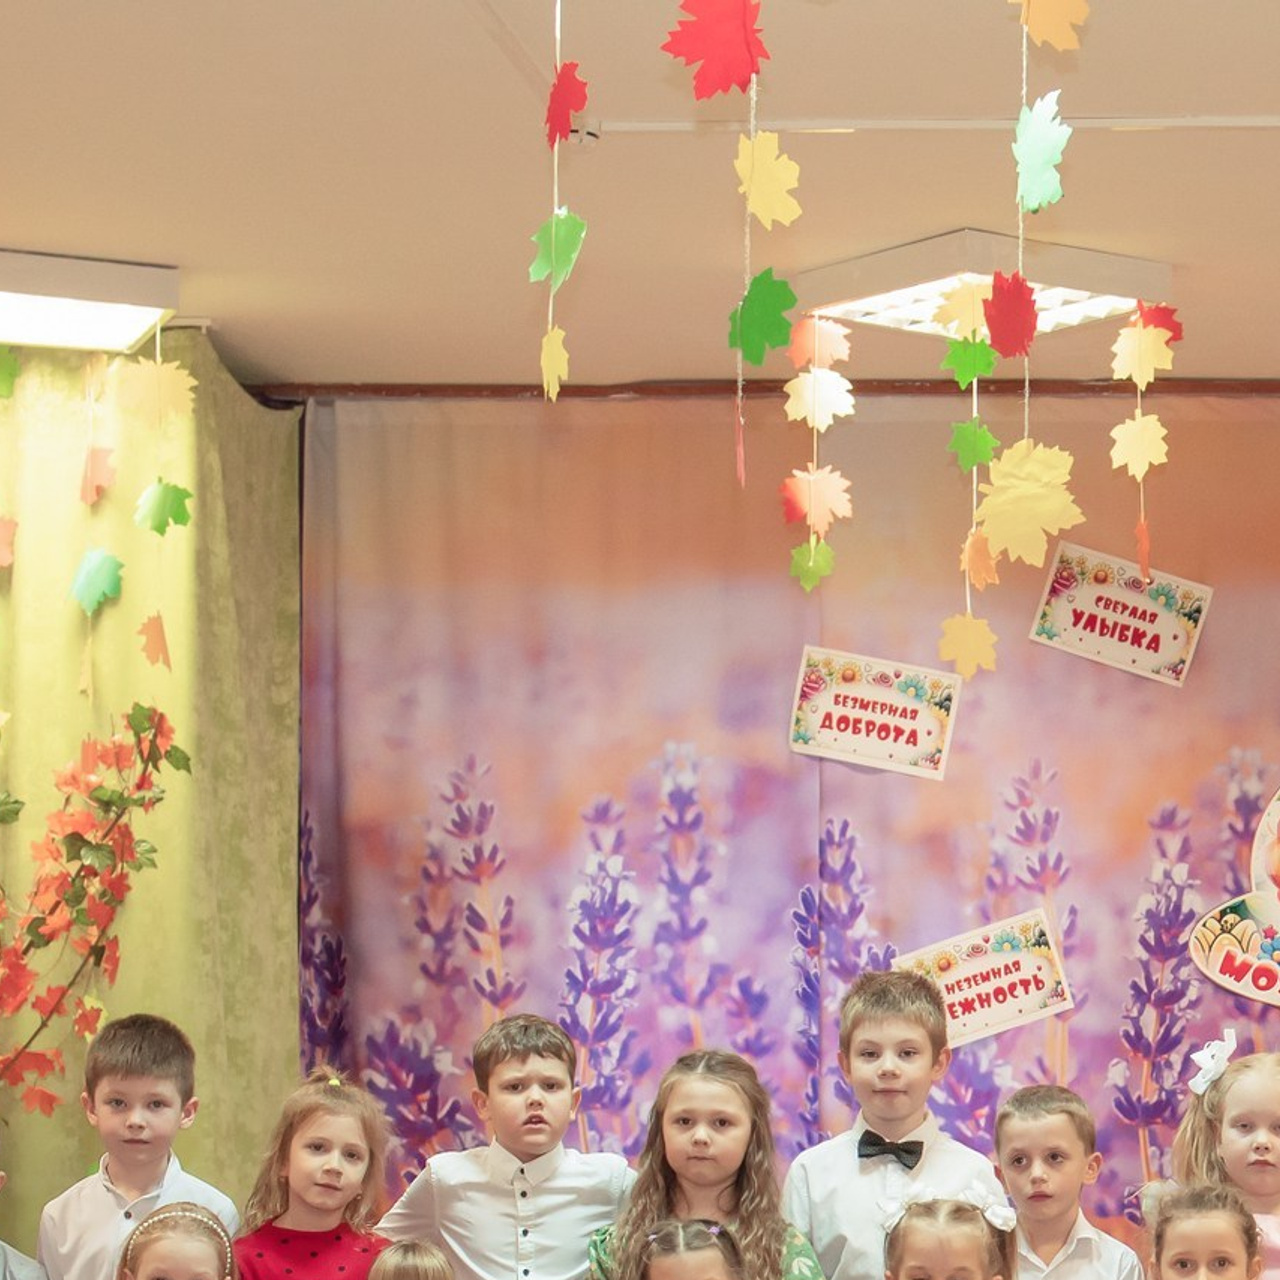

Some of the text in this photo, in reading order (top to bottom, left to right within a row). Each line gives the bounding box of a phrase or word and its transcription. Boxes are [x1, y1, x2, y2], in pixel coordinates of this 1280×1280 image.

[1095, 594, 1159, 625] СВЕТЛАЯ
[1071, 607, 1161, 653] УЛЫБКА
[834, 695, 919, 720] БЕЗМЕРНАЯ
[820, 712, 918, 746] ДОБРОТА
[945, 960, 1021, 994] НЕЗЕМНАЯ
[946, 974, 1045, 1019] ЕЖНОСТЬ
